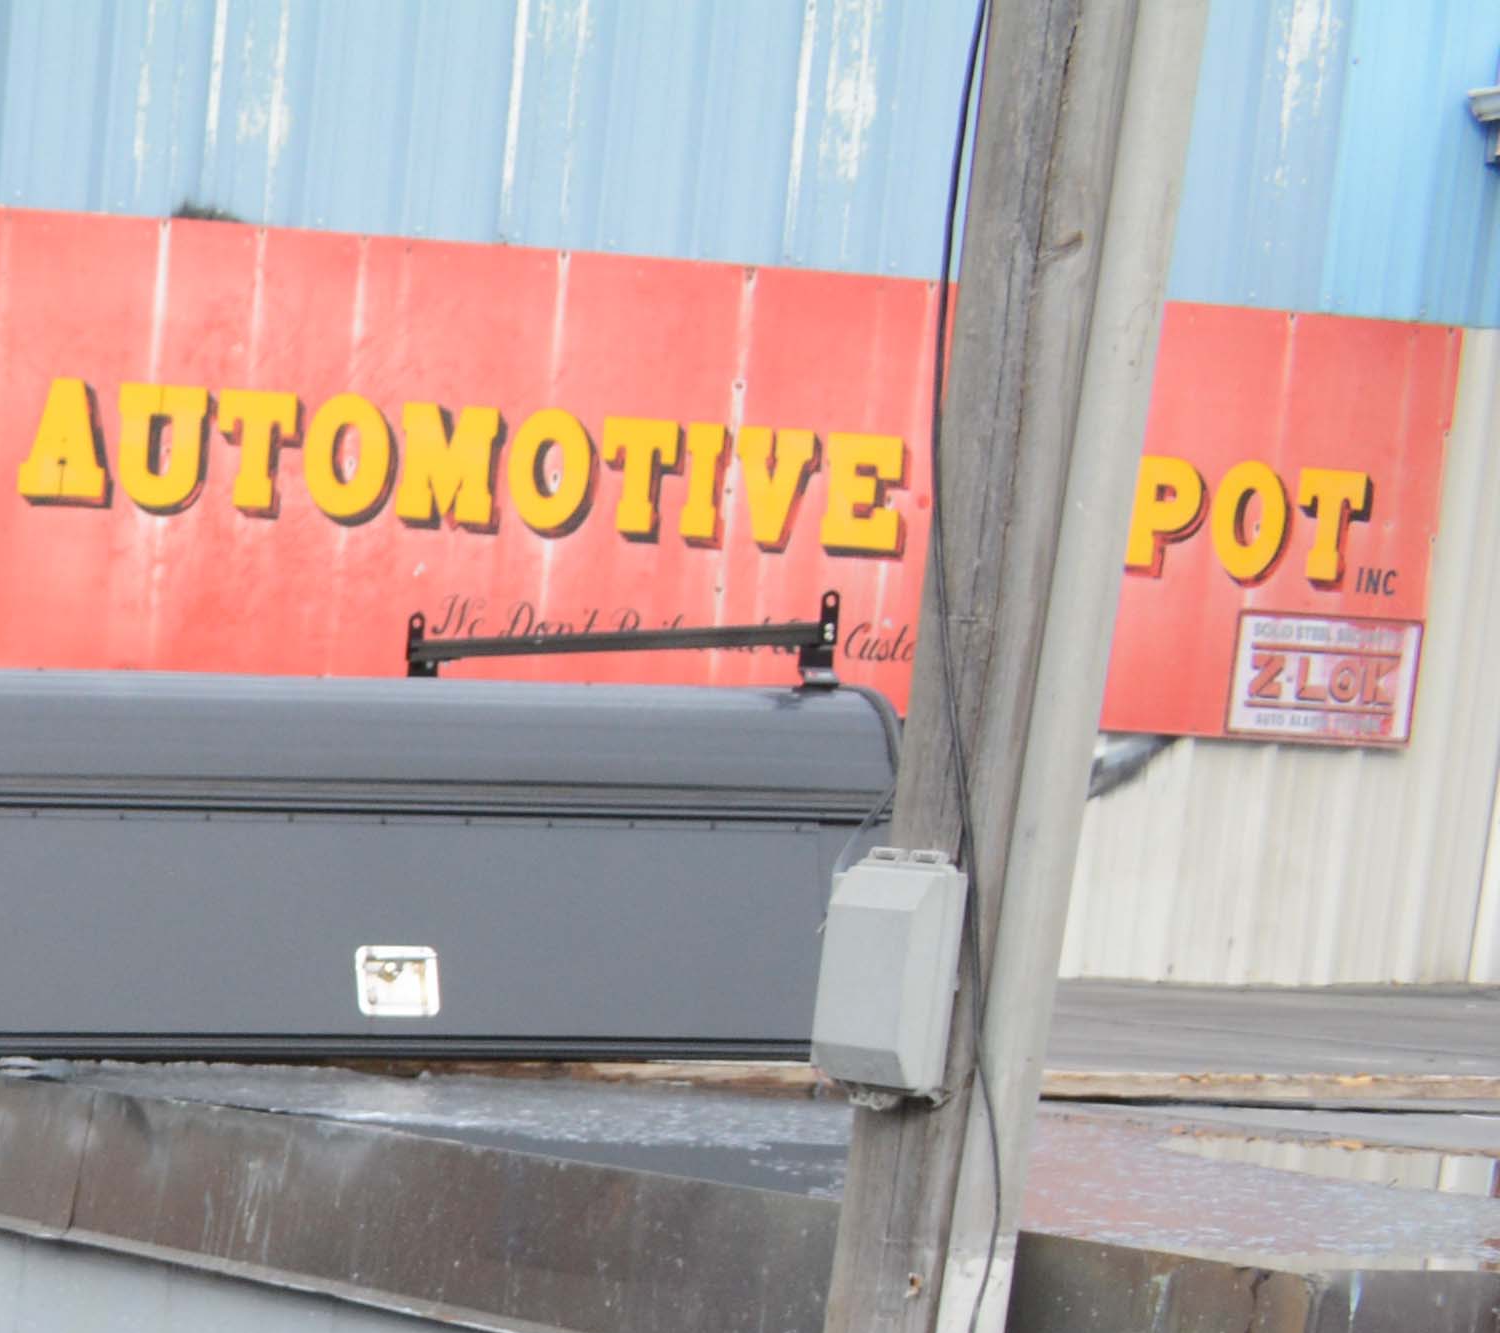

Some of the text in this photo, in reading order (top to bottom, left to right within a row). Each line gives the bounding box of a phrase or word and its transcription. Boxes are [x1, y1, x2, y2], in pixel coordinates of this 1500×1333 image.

[17, 377, 1372, 593] AUTOMOTIVE POT
[1355, 566, 1398, 597] INC
